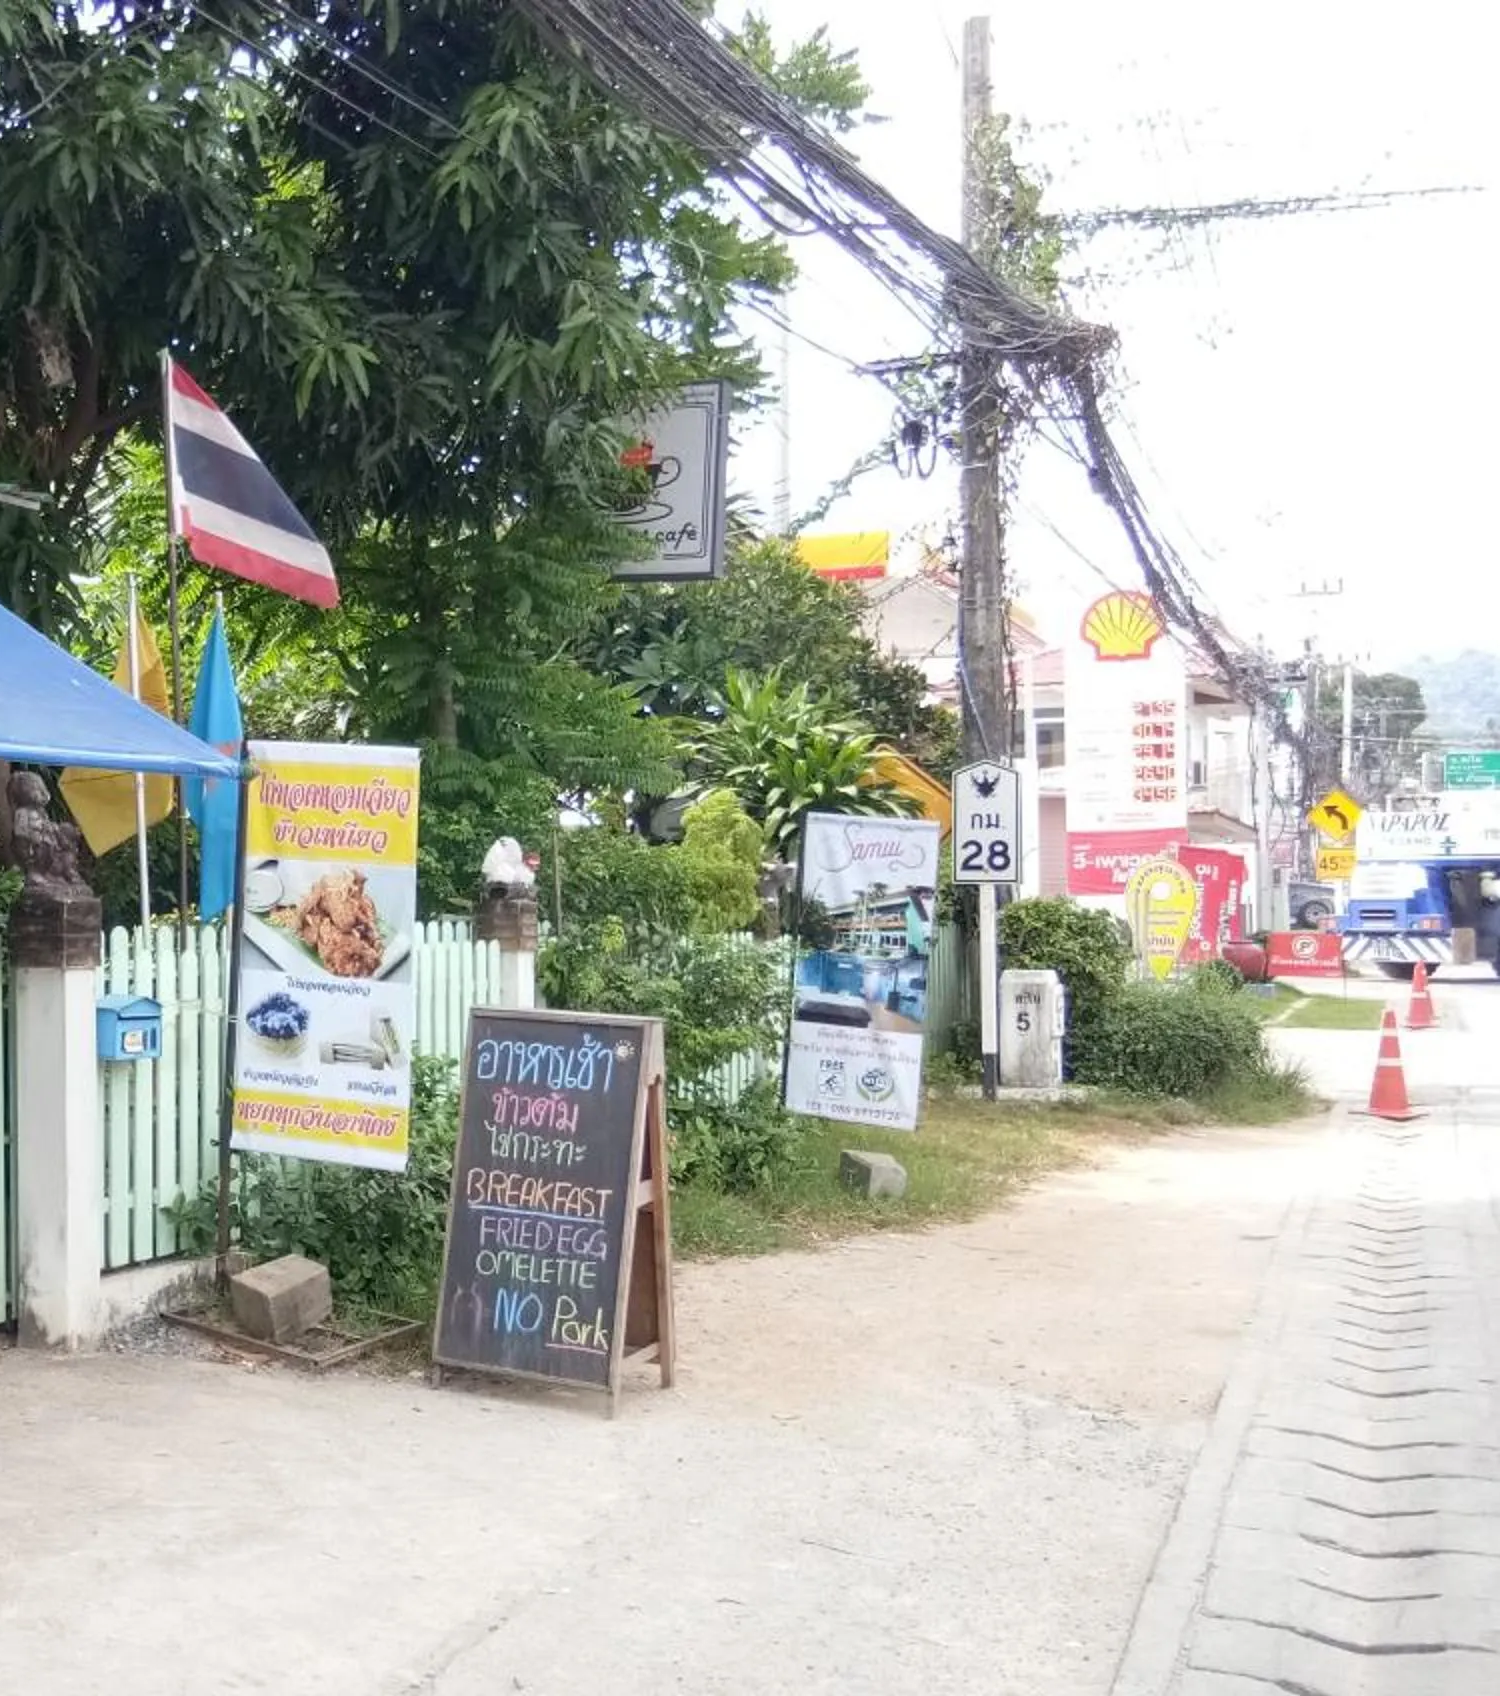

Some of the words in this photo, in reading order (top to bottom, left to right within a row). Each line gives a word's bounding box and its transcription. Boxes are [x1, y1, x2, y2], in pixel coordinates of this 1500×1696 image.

[273, 818, 389, 854] ข้าวเหนียว
[961, 840, 1011, 872] 28
[1319, 855, 1340, 872] 45
[1016, 1011, 1030, 1032] 5
[477, 1033, 614, 1093] อาหารเช้า
[492, 1087, 579, 1133] ข้าวต้ม
[484, 1120, 587, 1166] ไข่กระทะ
[466, 1167, 613, 1218] BREAKFAST
[479, 1215, 553, 1251] FRIED
[557, 1225, 607, 1261] EGG
[476, 1249, 597, 1289] OMELETTE
[494, 1287, 543, 1334] NO
[552, 1295, 609, 1350] Park
